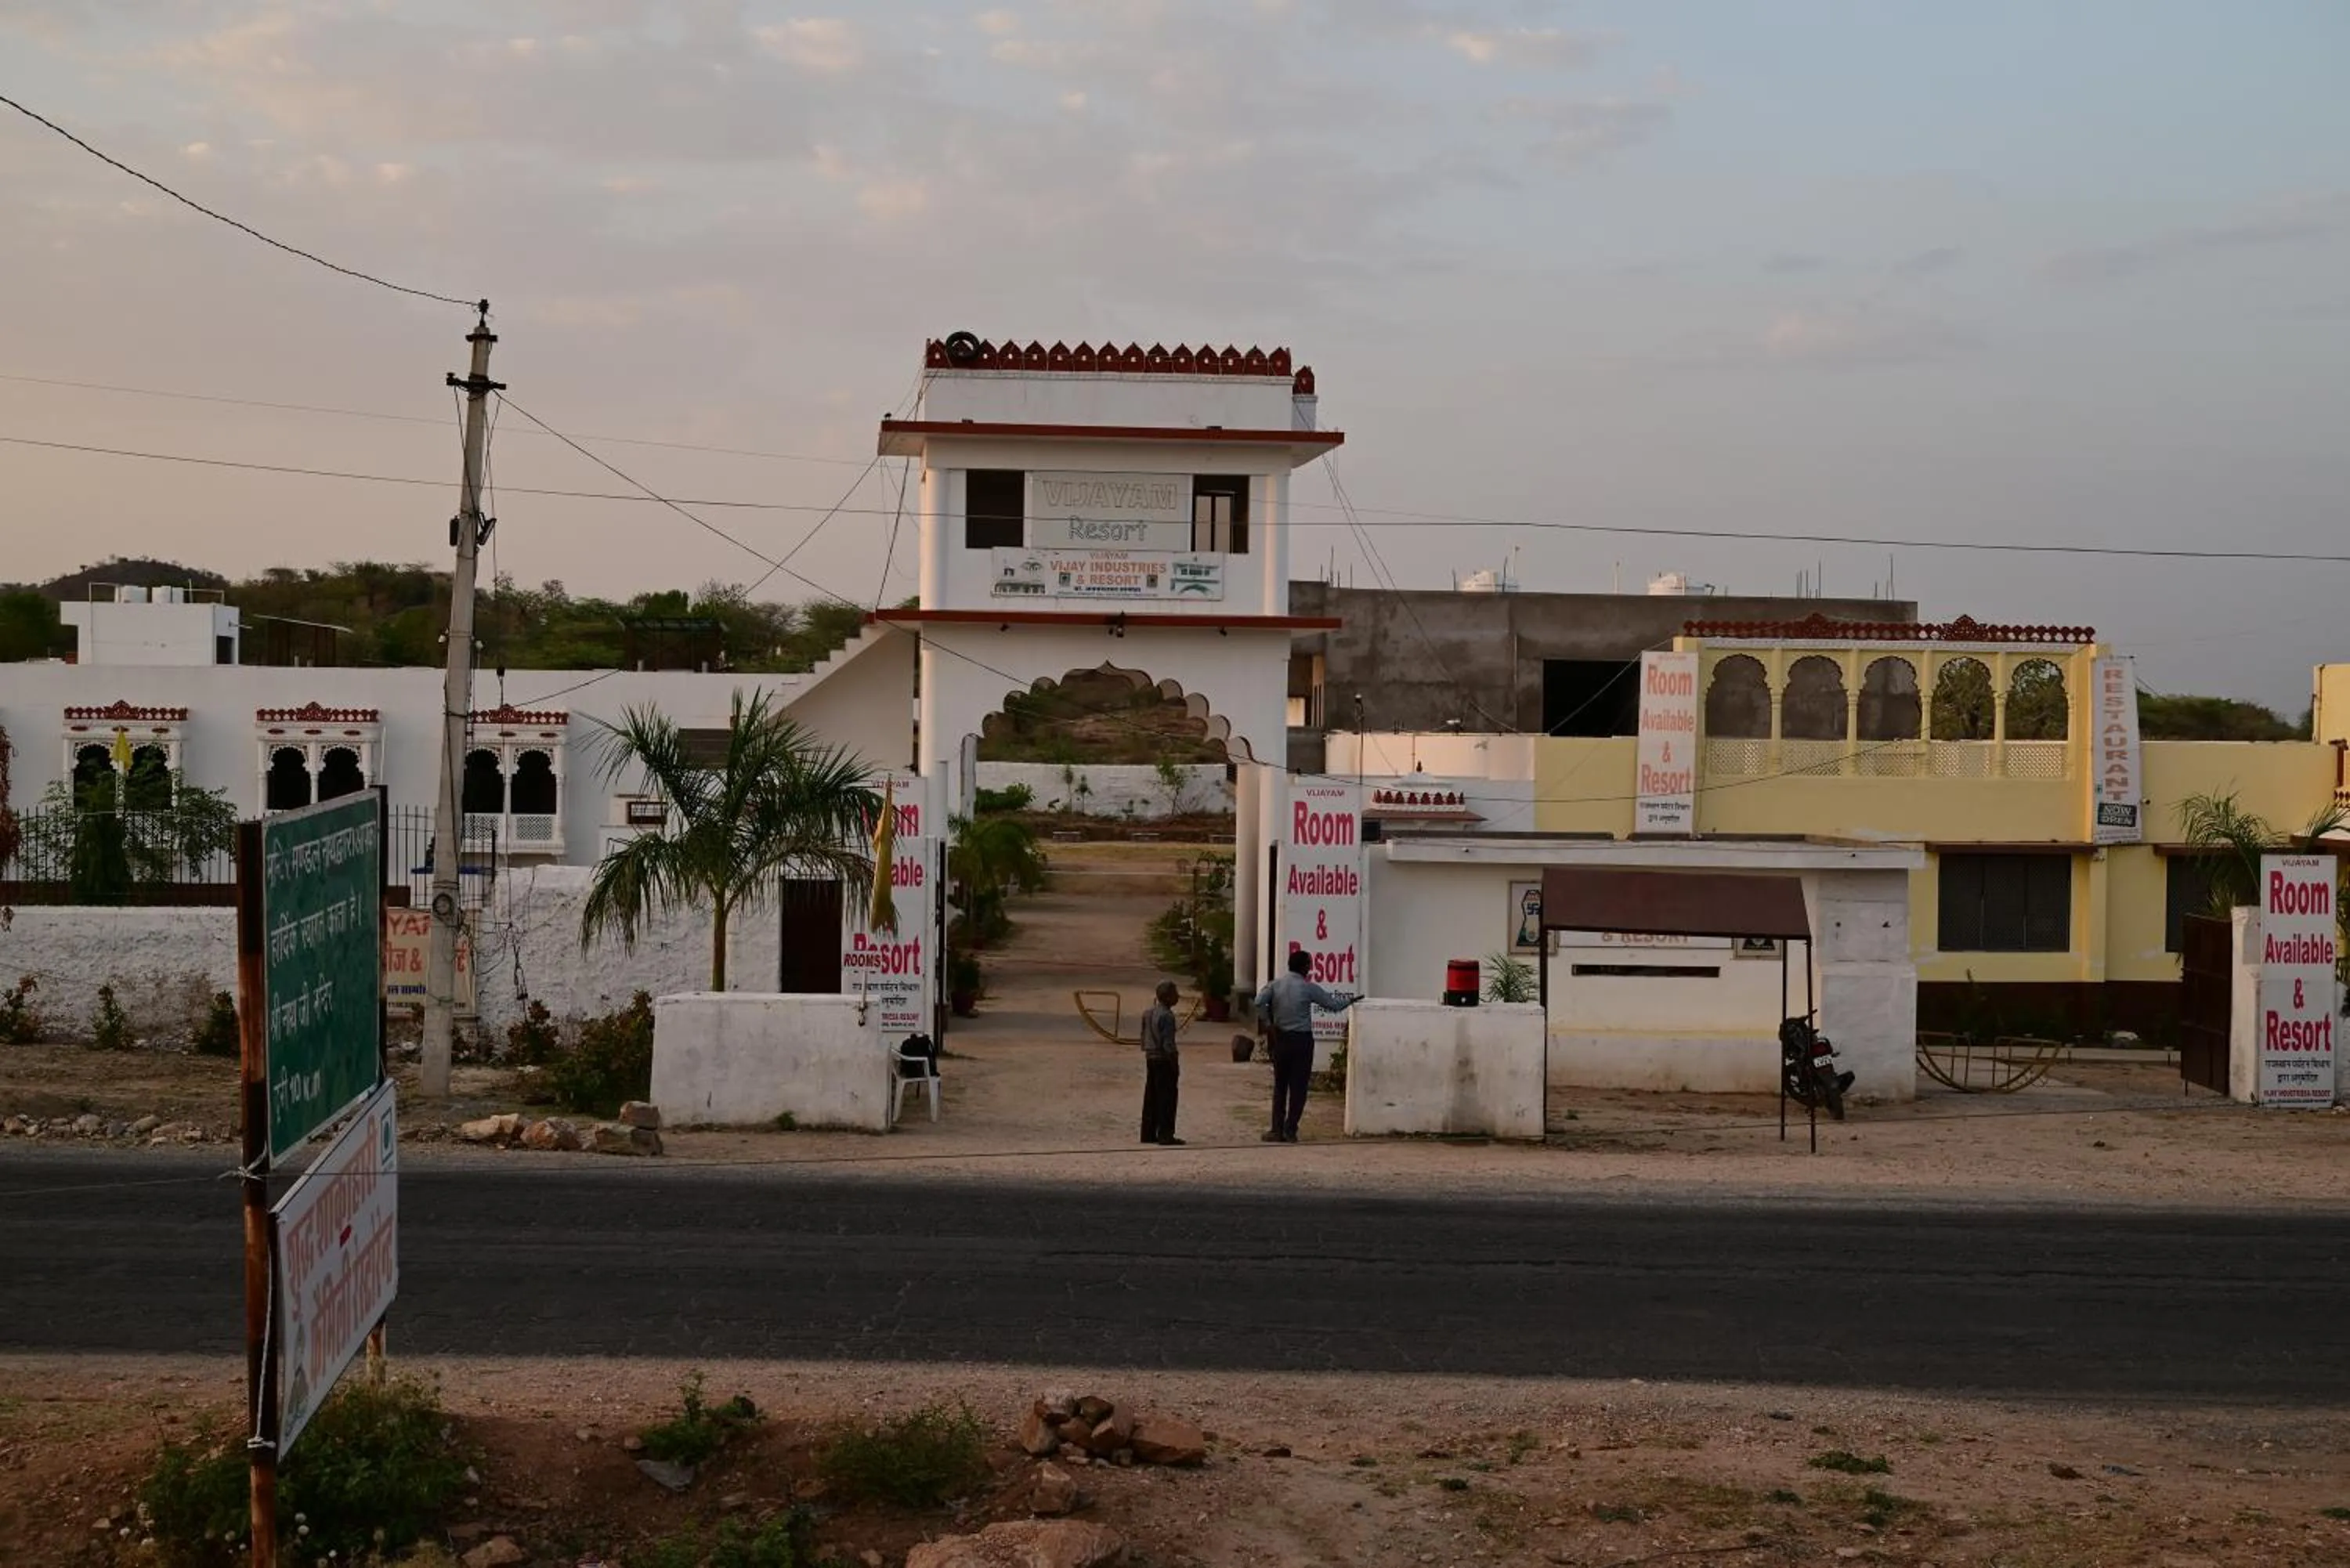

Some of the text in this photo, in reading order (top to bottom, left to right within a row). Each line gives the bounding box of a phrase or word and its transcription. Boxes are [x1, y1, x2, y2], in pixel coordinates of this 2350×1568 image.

[1042, 480, 1177, 510] VIJAYAM
[1067, 515, 1148, 541] Resort
[1050, 561, 1086, 571] VIJAY
[1090, 562, 1166, 573] INDUSTRIES
[1076, 575, 1141, 586] & RESORT
[1647, 664, 1692, 695] Room
[1642, 707, 1694, 732] Available
[2104, 669, 2128, 800] RESTAURANT
[1661, 741, 1671, 763] &
[1641, 764, 1692, 794] Resort
[1294, 801, 1354, 844] Room
[2104, 805, 2131, 815] NOW
[1289, 865, 1358, 895] Available
[2269, 871, 2329, 915] Room
[1316, 909, 1327, 940] &
[844, 953, 880, 967] ROOMS
[2265, 934, 2334, 965] Available
[2293, 977, 2304, 1009] &
[2266, 1010, 2331, 1051] Resort
